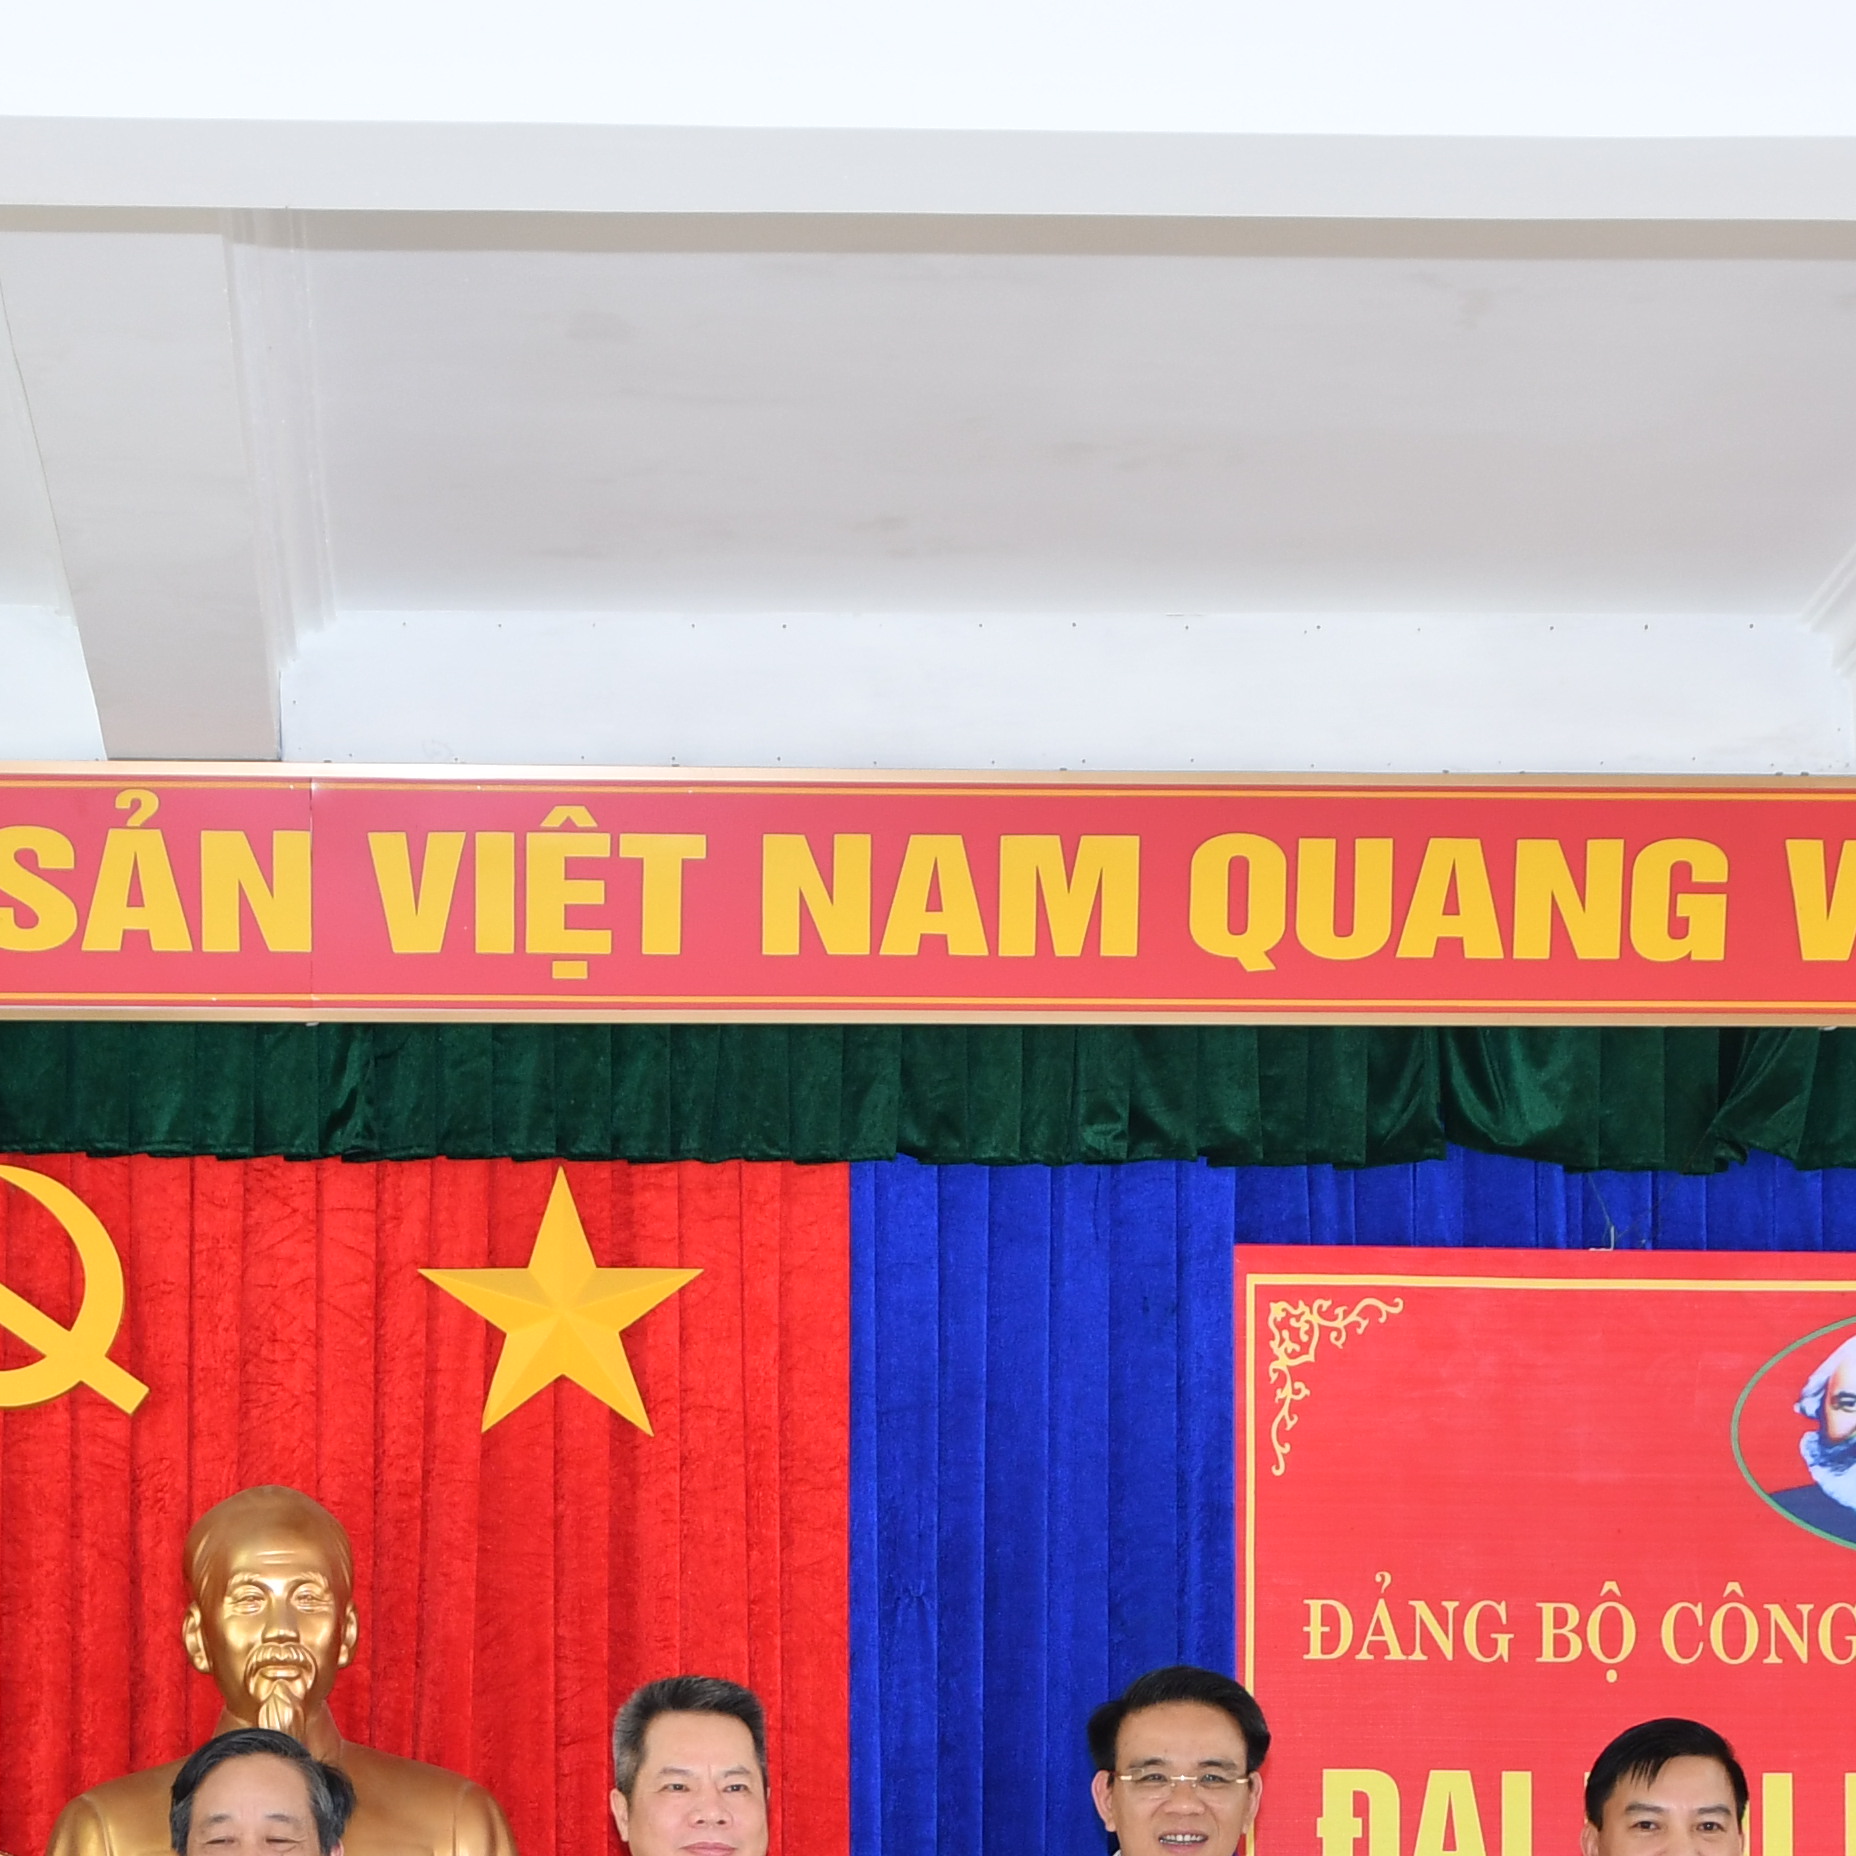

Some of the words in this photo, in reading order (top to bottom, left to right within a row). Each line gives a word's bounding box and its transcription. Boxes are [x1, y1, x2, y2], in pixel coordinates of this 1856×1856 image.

[368, 805, 707, 979] VIỆT
[762, 834, 1140, 957] NAM
[1188, 832, 1730, 972] QUANG
[1301, 1571, 1515, 1663] ĐẢNG
[1535, 1580, 1637, 1683] BỘ
